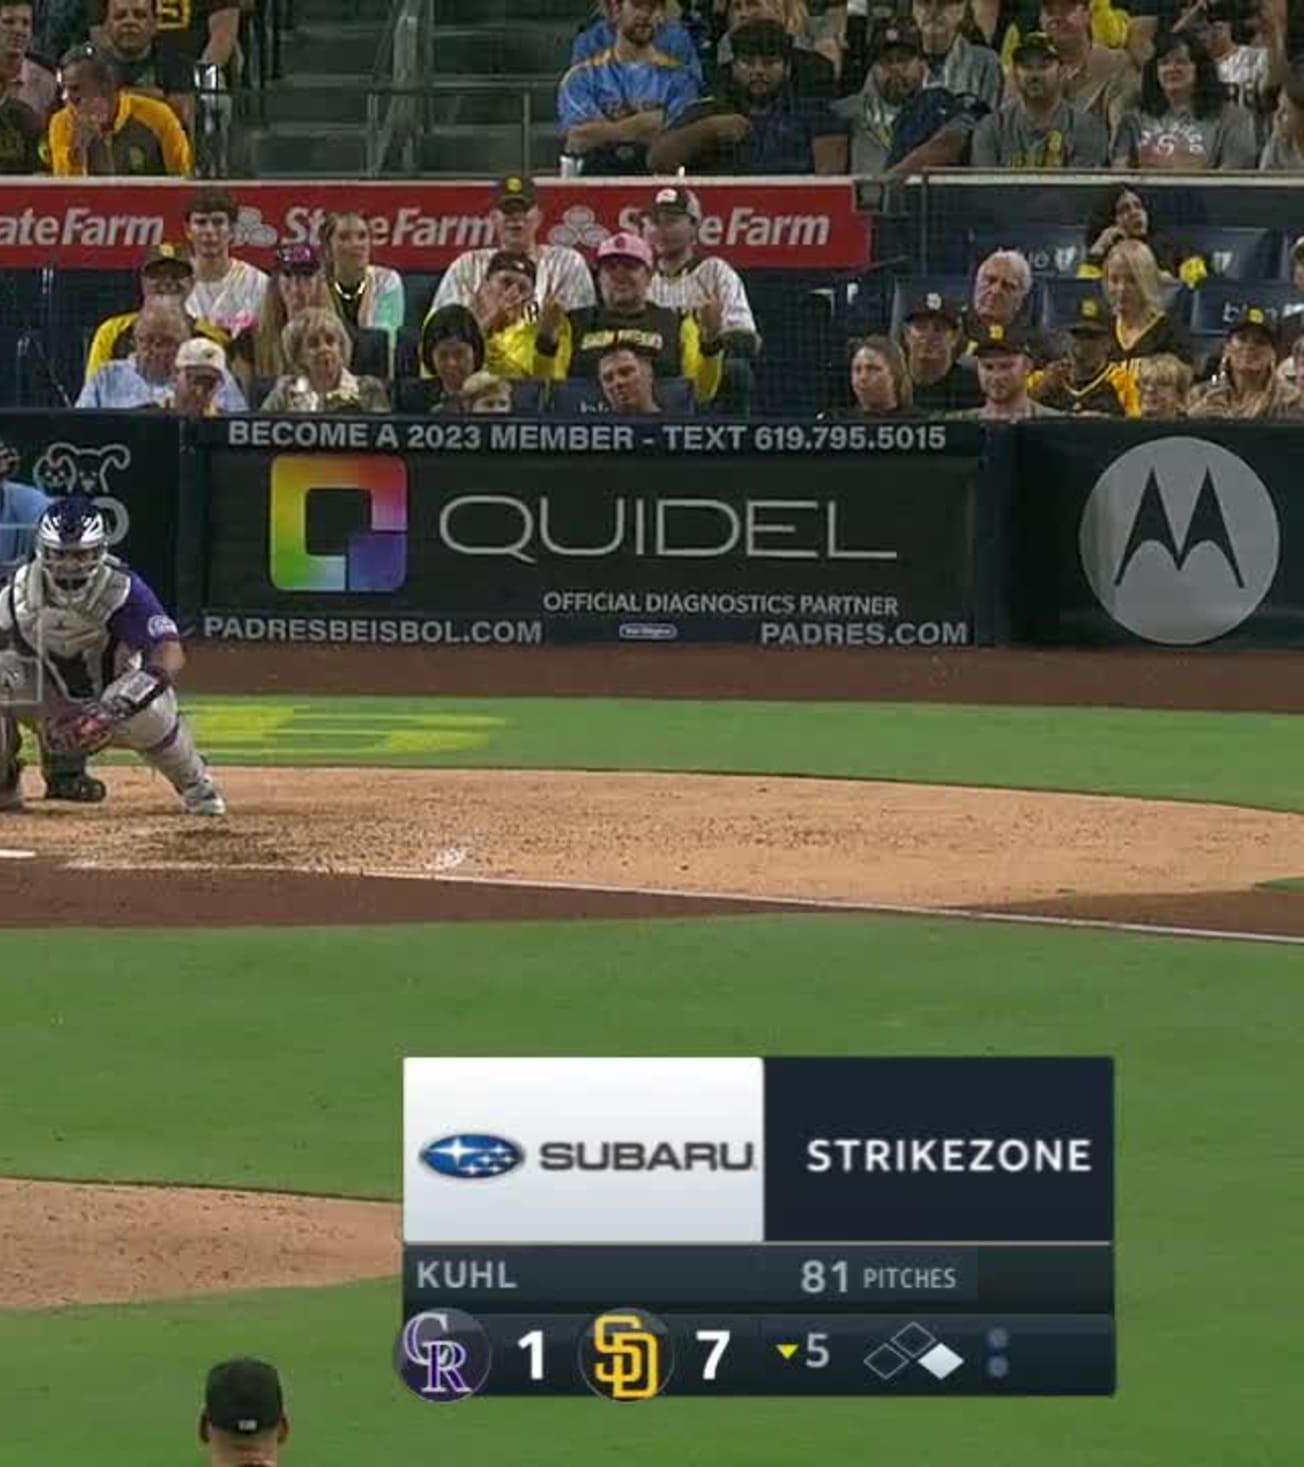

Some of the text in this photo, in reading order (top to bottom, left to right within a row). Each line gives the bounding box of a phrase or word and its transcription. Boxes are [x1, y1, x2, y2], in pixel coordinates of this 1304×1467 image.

[228, 421, 368, 447] BECOME
[375, 423, 400, 448] A
[407, 424, 482, 449] 2023
[490, 425, 634, 450] MEMBER
[661, 426, 746, 450] TEXT
[754, 426, 946, 450] 619.795.5015
[439, 495, 897, 563] QUIDEL
[542, 592, 899, 617] OFFICIAL DIAGNOSTICS PARTNER
[203, 615, 542, 644] PADRESBEISBOL.COM
[761, 621, 968, 646] PADRES.COM
